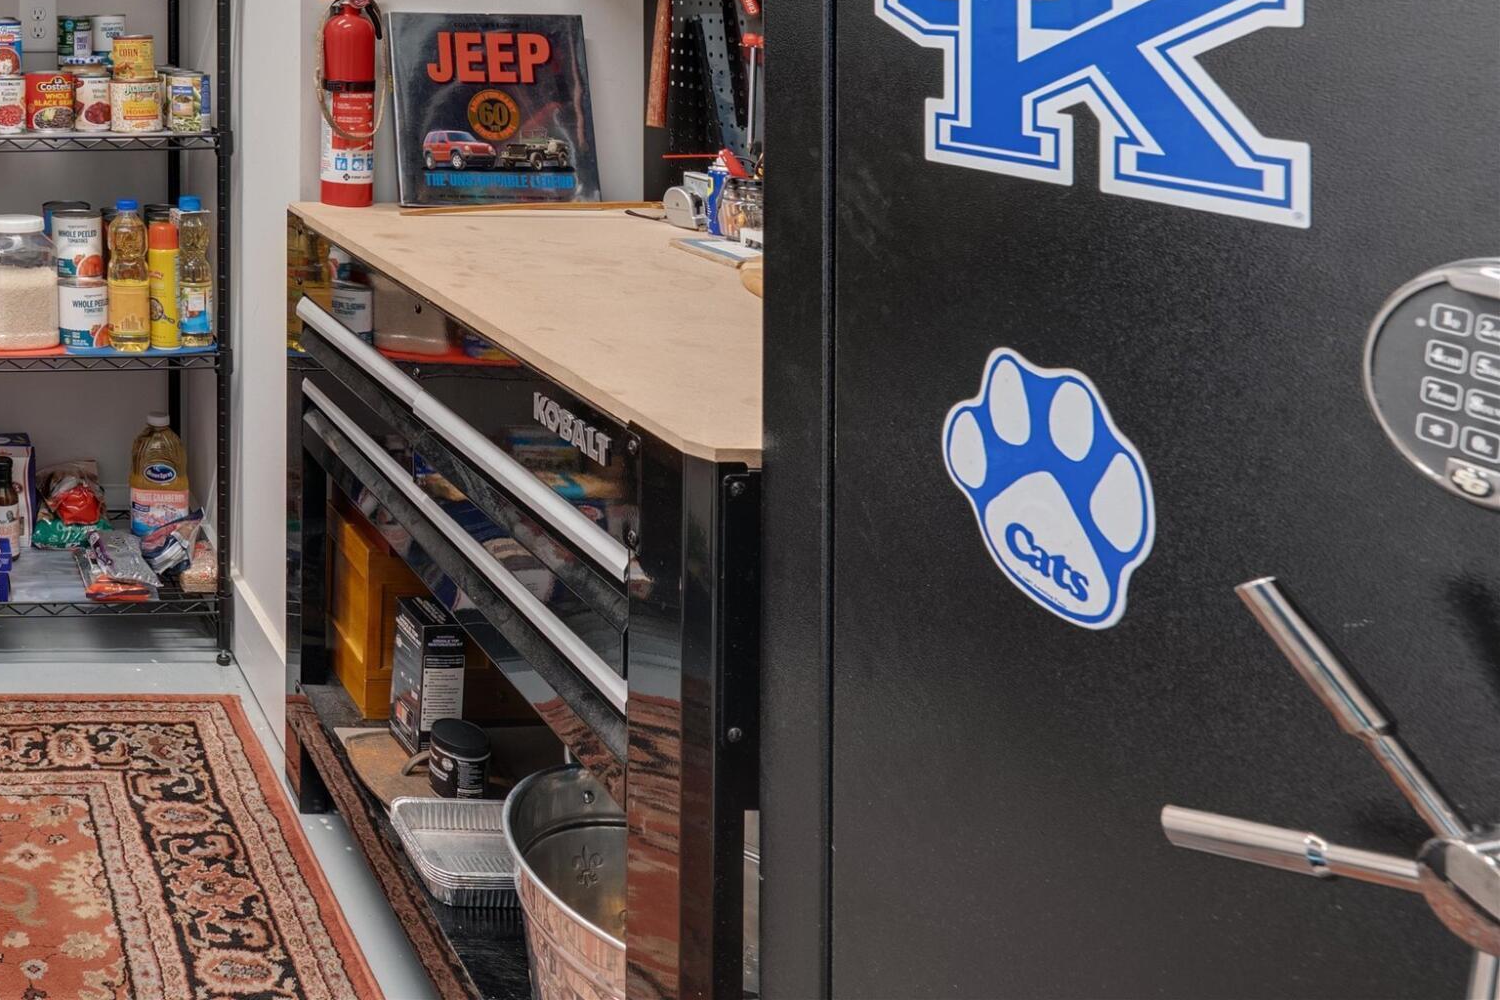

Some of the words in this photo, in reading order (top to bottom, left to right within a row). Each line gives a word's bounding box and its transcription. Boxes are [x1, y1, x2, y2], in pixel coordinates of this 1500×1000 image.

[427, 31, 551, 84] JEEP
[478, 102, 510, 127] 60
[426, 172, 446, 187] THE
[58, 230, 77, 238] WHOLE
[77, 229, 97, 238] PEELED
[533, 391, 612, 467] KOBALT
[1005, 522, 1089, 602] Cats
